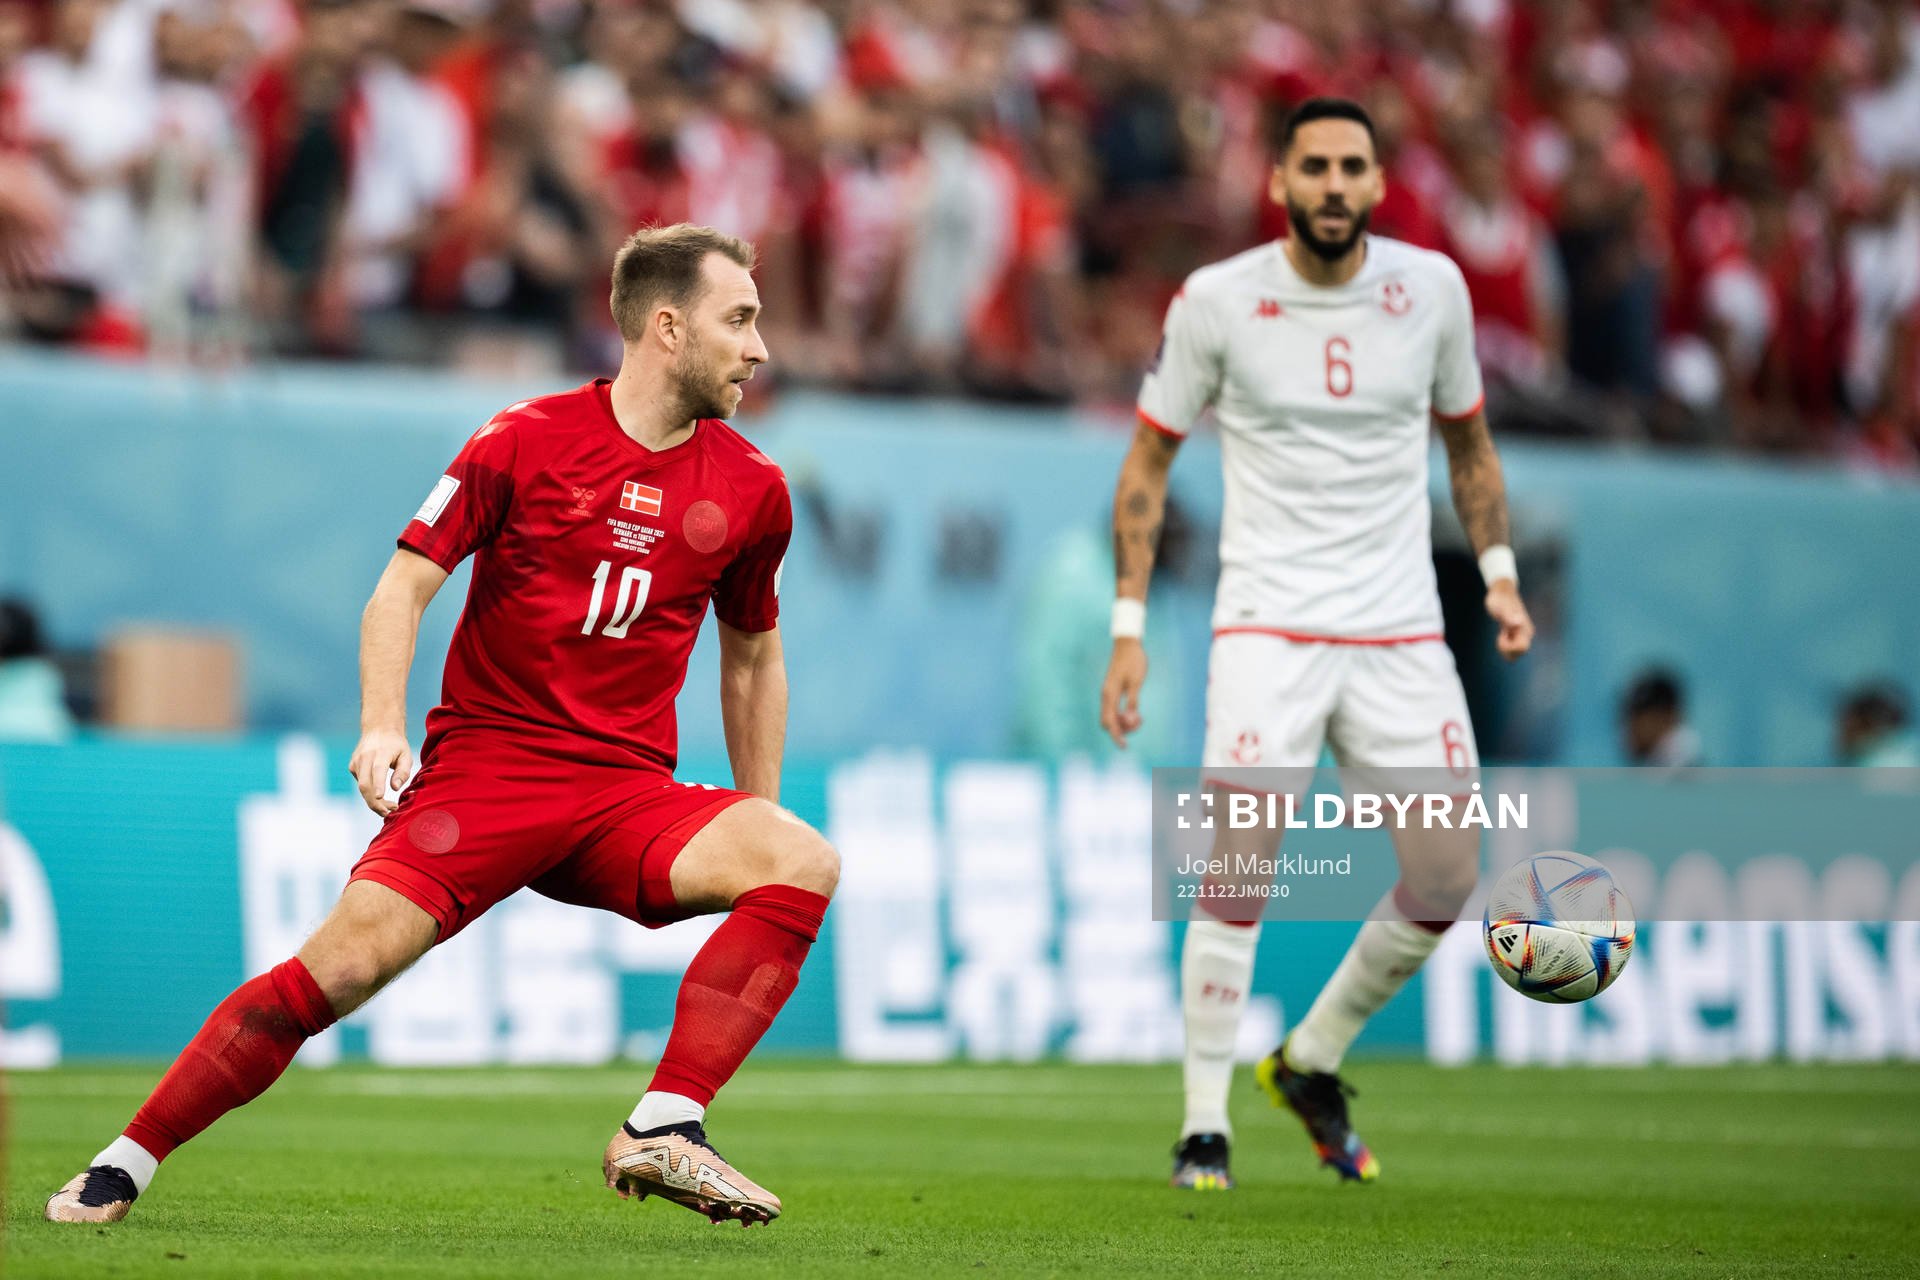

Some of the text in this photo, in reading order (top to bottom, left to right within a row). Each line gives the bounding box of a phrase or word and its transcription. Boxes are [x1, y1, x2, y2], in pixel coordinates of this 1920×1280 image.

[1325, 335, 1354, 399] 6
[607, 518, 617, 527] FIFA
[617, 520, 632, 530] WORLD
[631, 524, 641, 532] CUP
[581, 560, 653, 639] 10
[1441, 720, 1470, 780] 6
